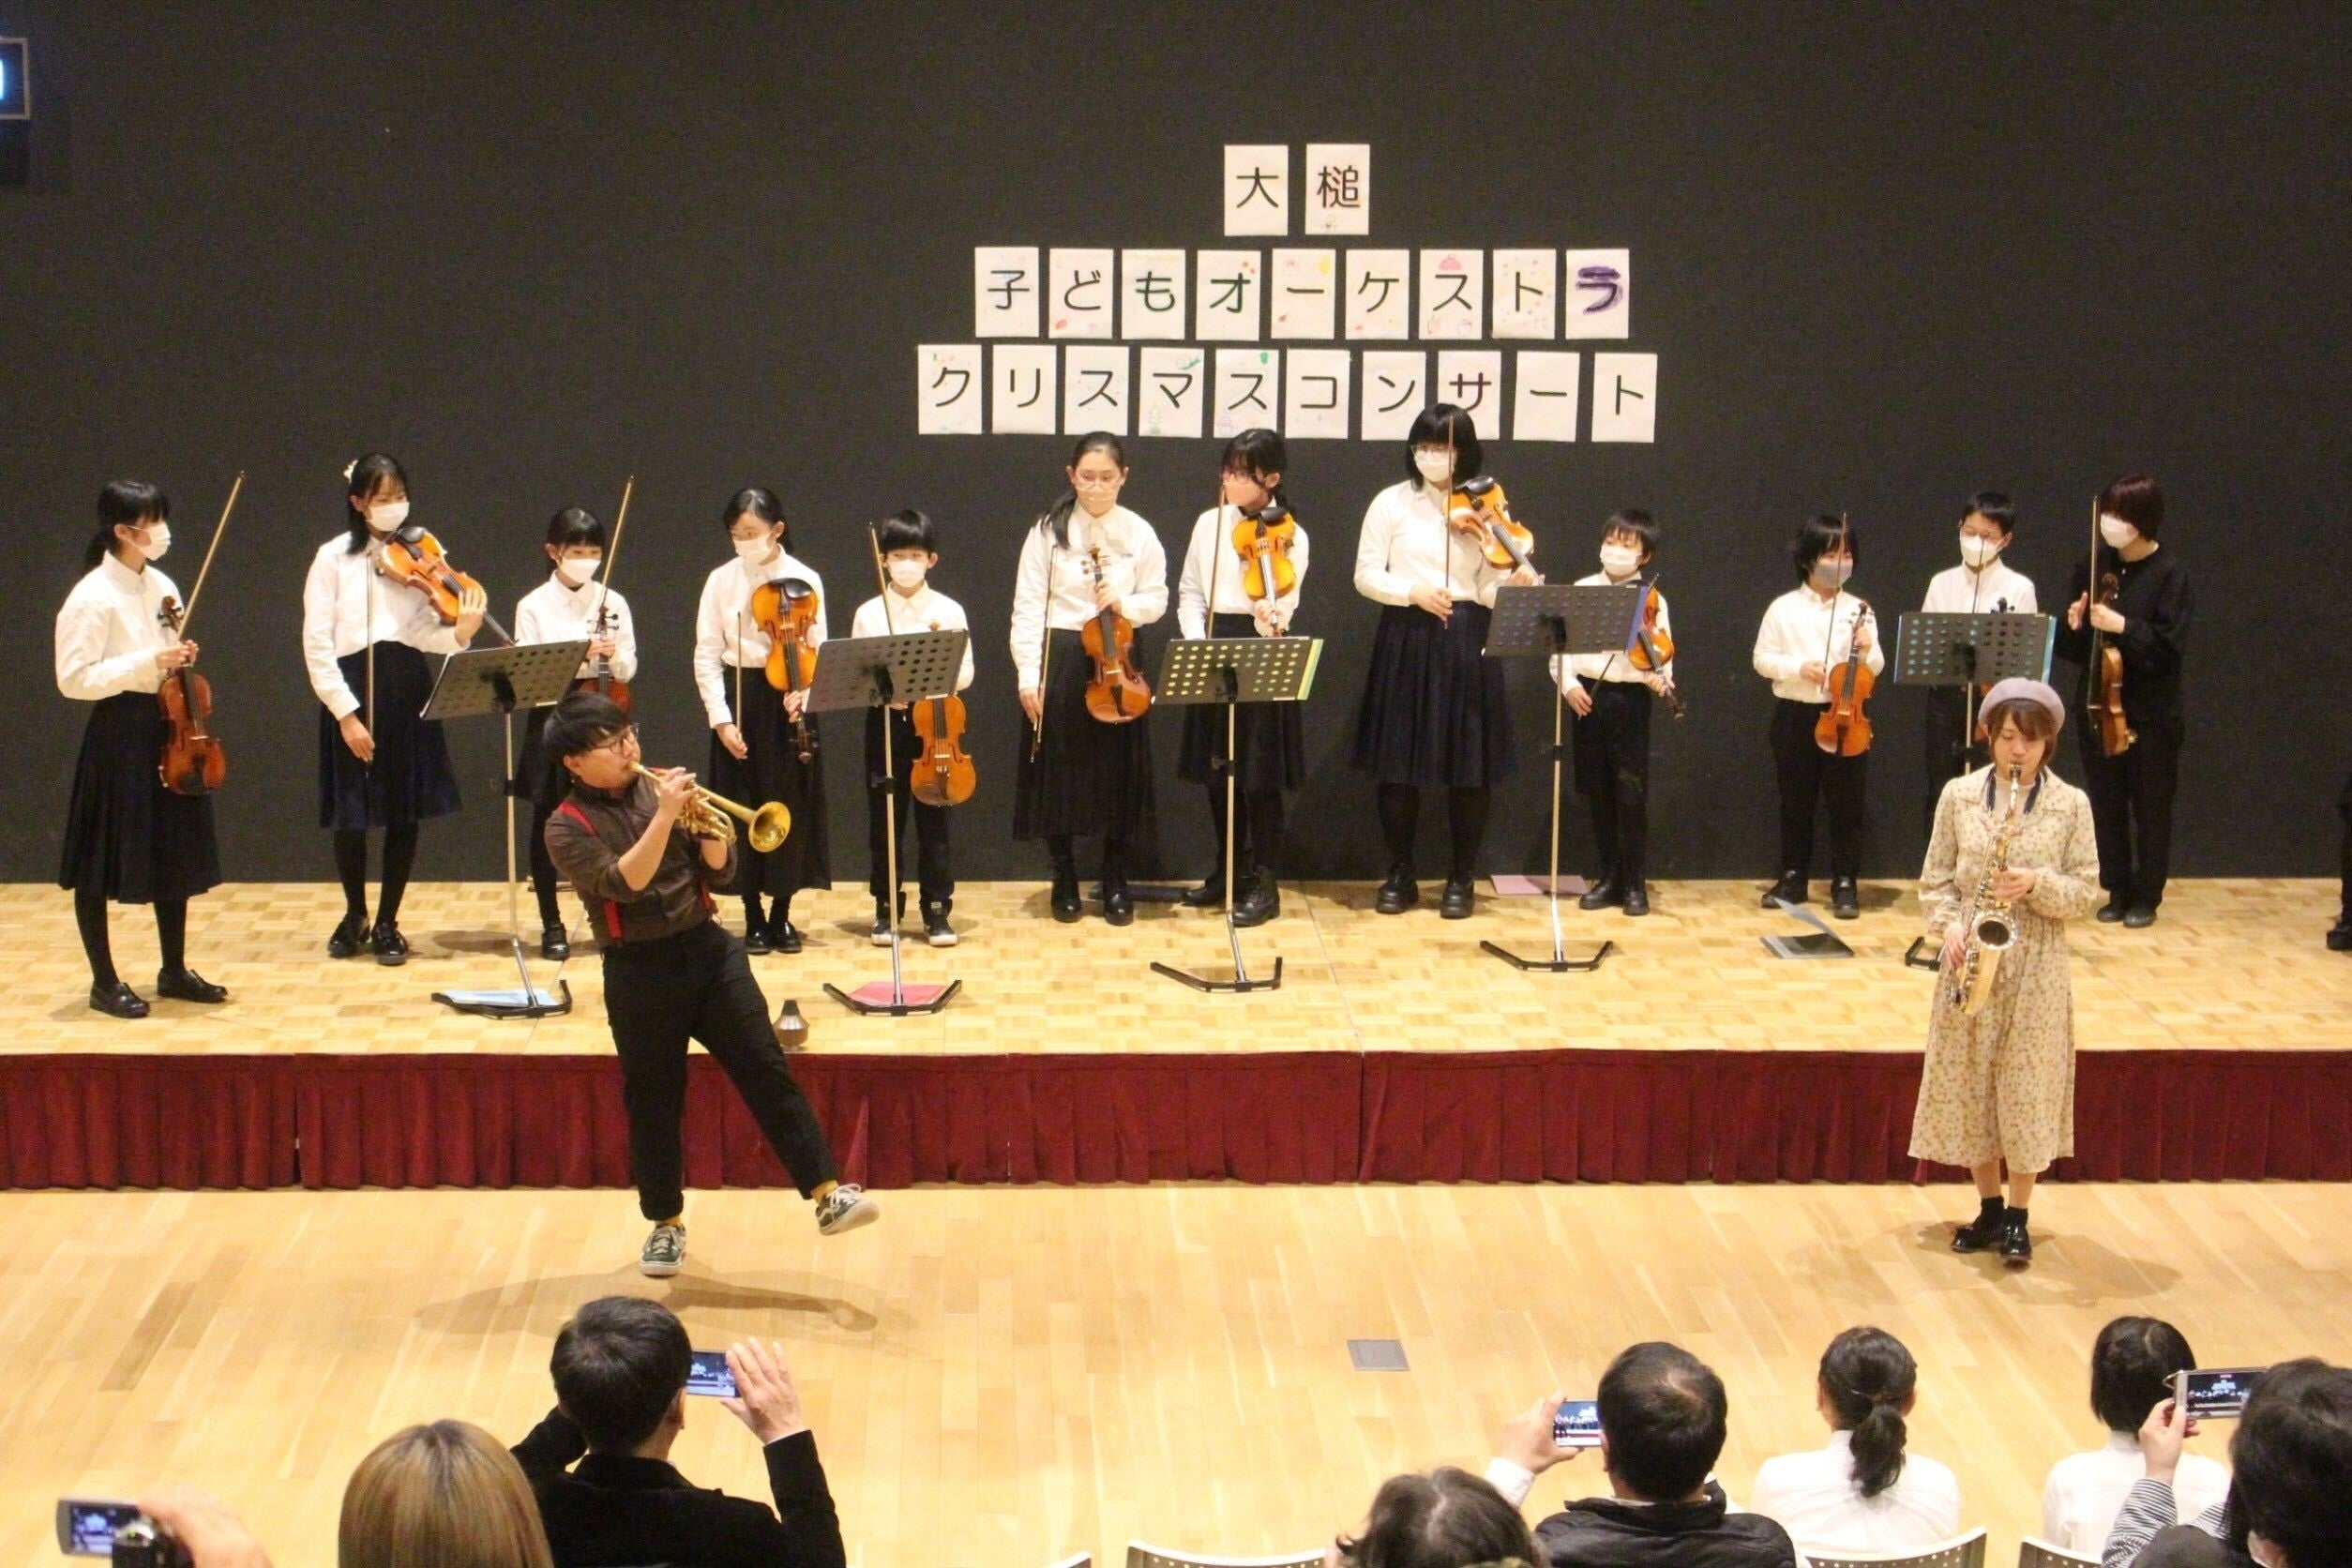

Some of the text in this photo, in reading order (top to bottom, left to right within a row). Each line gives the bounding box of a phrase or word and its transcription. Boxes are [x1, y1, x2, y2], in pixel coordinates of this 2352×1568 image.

[1235, 166, 1361, 208] 大槌
[988, 266, 1622, 313] 子どもオーケストラ
[931, 367, 1644, 415] クリスマスコンサート
